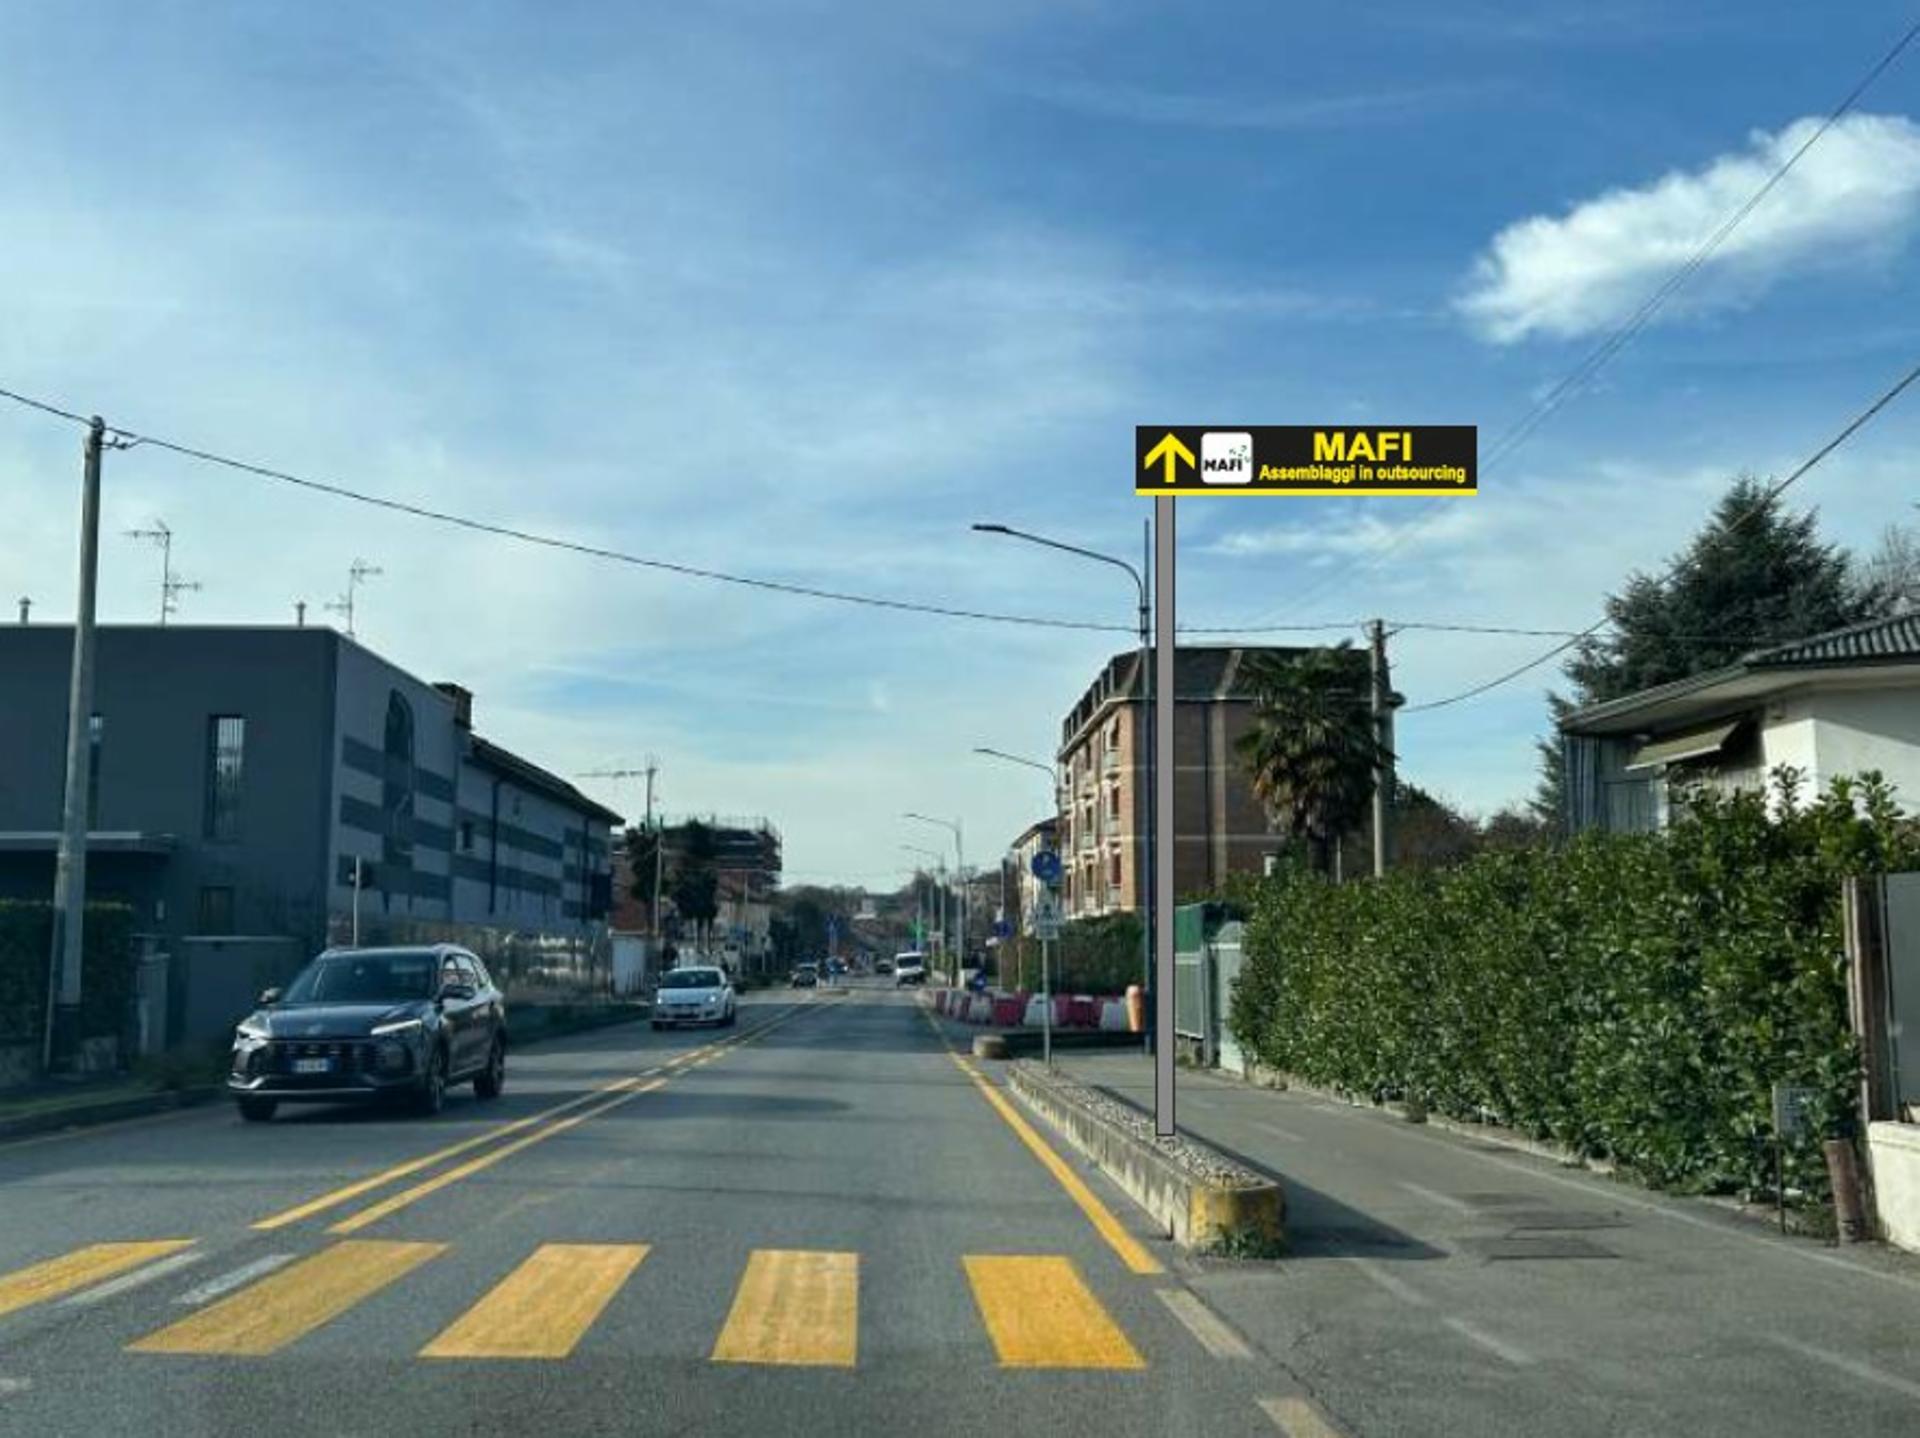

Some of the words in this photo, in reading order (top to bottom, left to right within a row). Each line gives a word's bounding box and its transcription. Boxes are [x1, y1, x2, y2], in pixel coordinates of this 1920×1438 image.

[1314, 432, 1412, 461] MAFI
[1259, 464, 1356, 484] Assemblaggi
[1359, 464, 1373, 480] in
[1377, 464, 1465, 484] outsourcing
